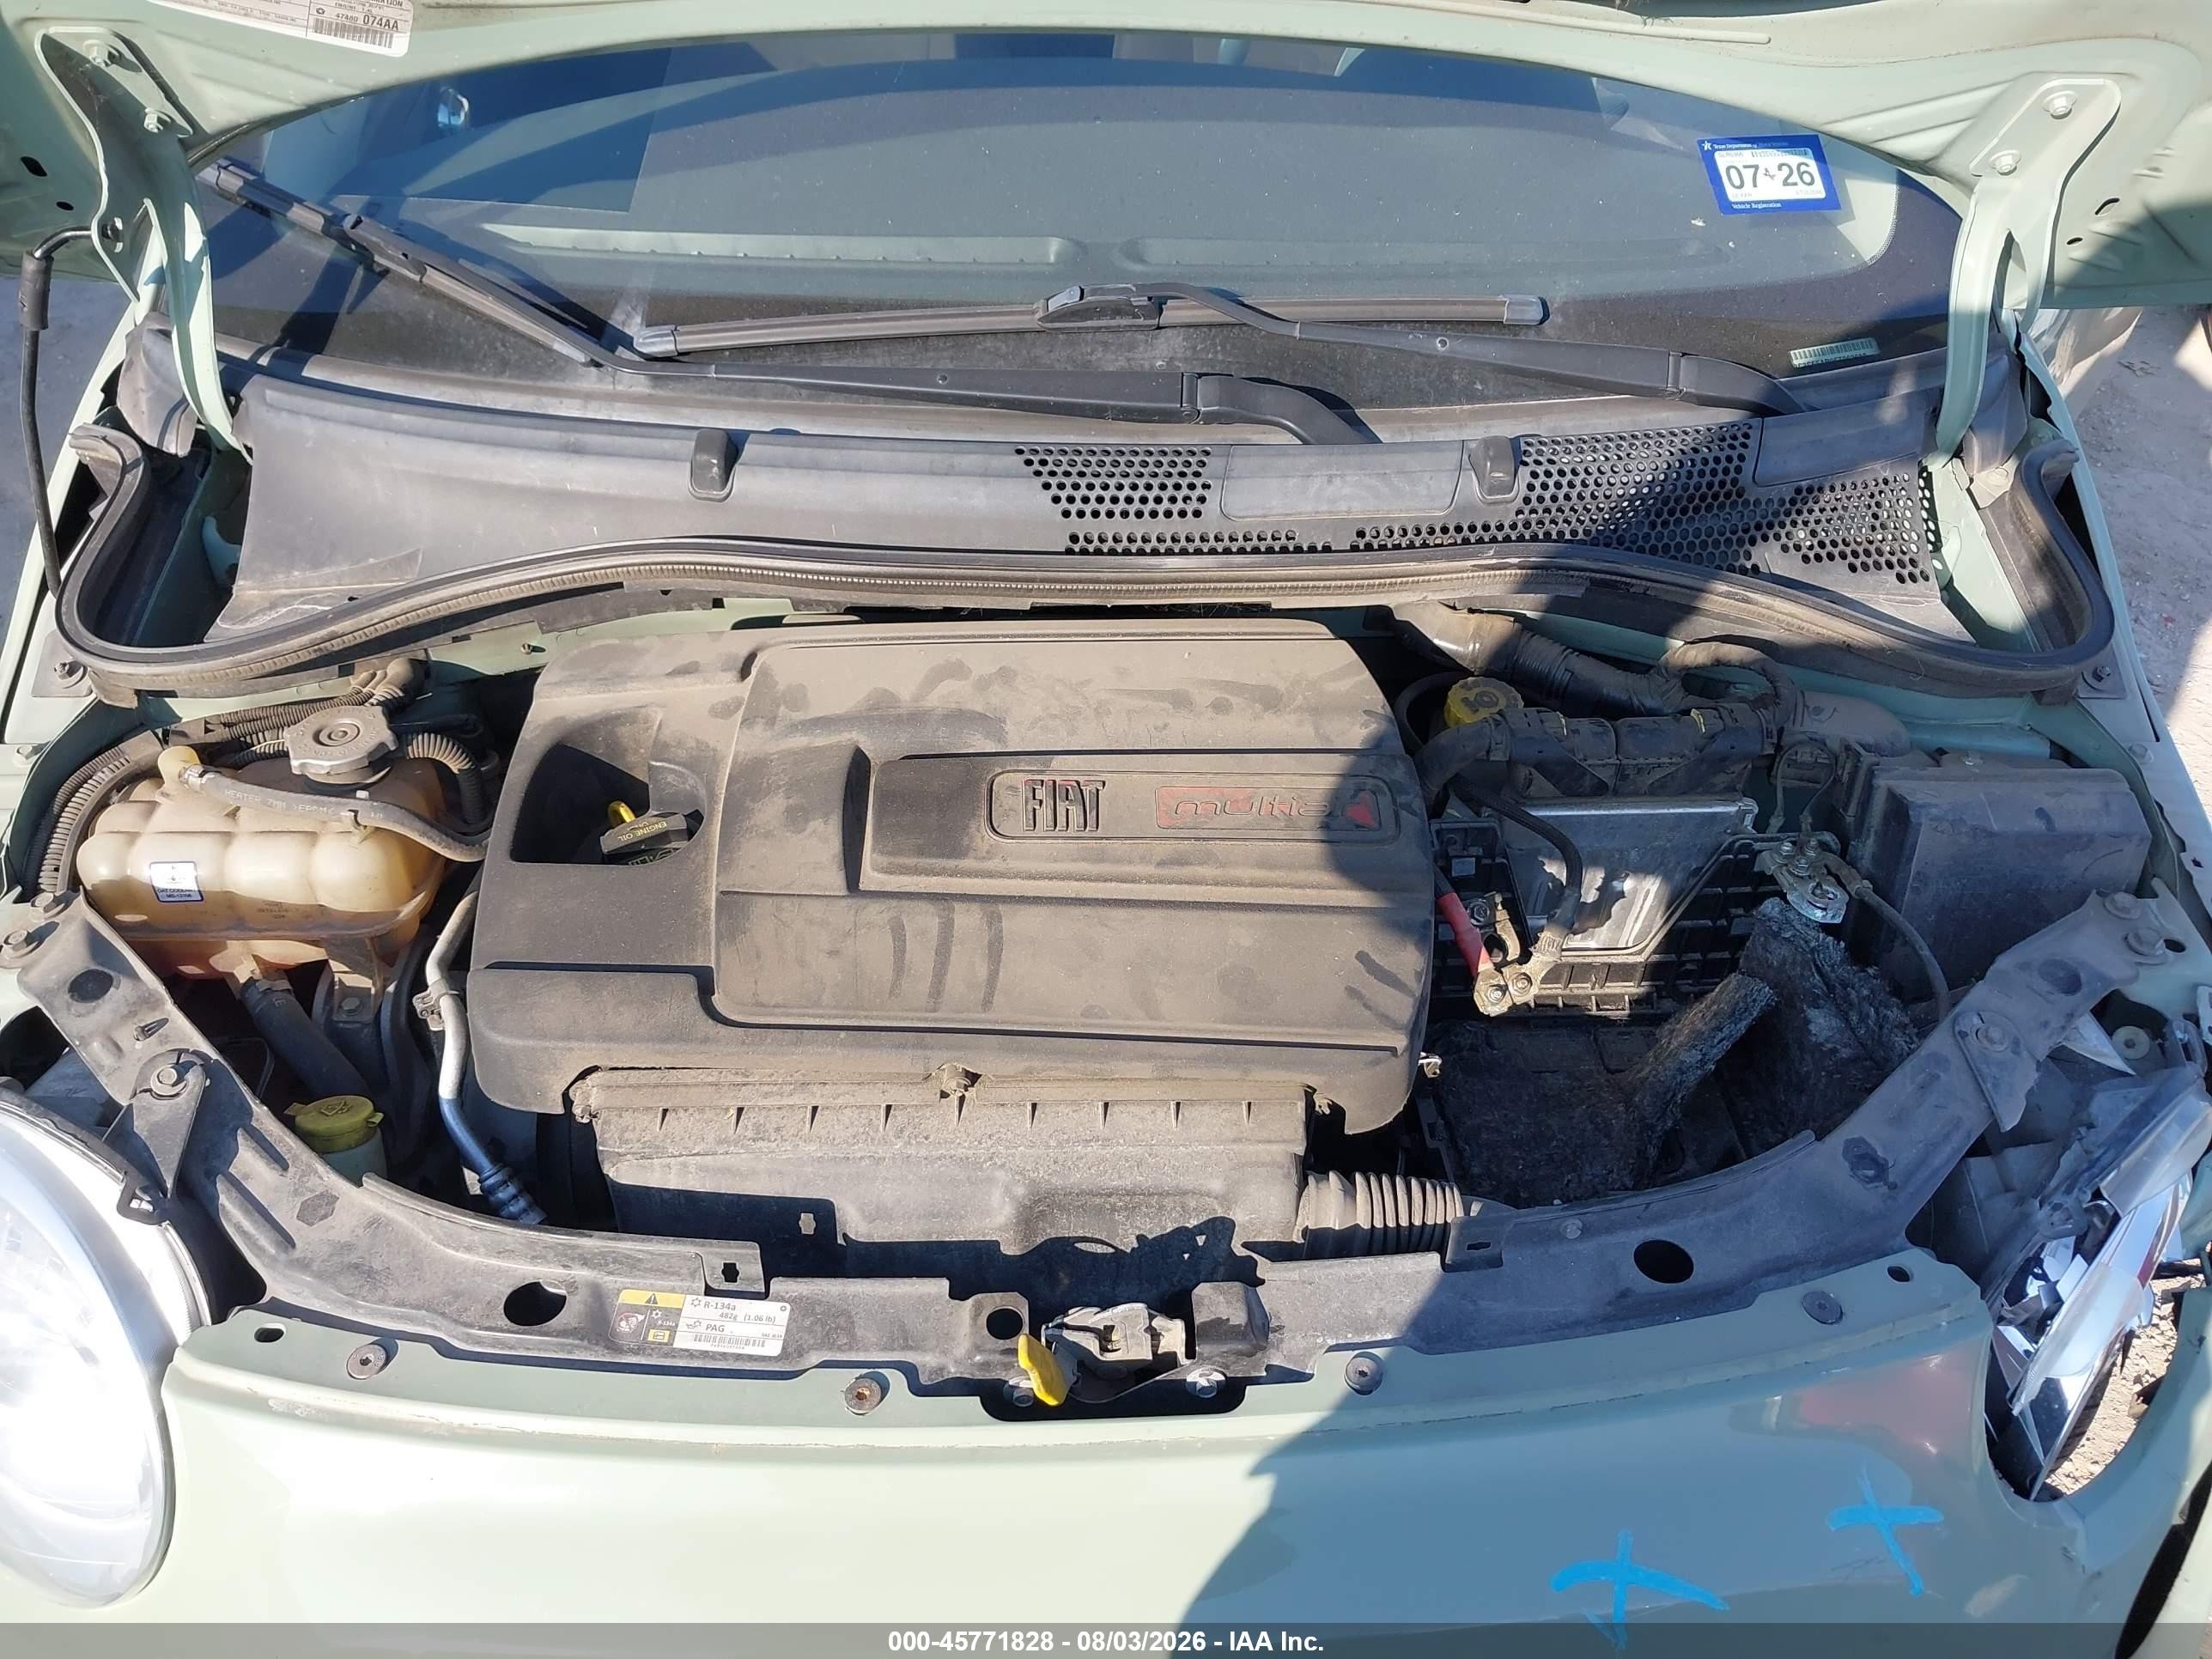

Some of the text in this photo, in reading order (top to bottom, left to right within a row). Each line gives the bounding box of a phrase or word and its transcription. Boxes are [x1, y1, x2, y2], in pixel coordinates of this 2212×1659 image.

[362, 14, 399, 31] 074AA
[1725, 161, 1815, 190] 07 26
[224, 789, 262, 804] HEATER
[1022, 778, 1106, 832] FIAT
[634, 821, 668, 837] ENGINE
[617, 833, 635, 842] OIL
[703, 1301, 737, 1311] R-134a
[719, 1312, 776, 1323] 482g (1.06 lb)
[705, 1323, 726, 1333] PAG
